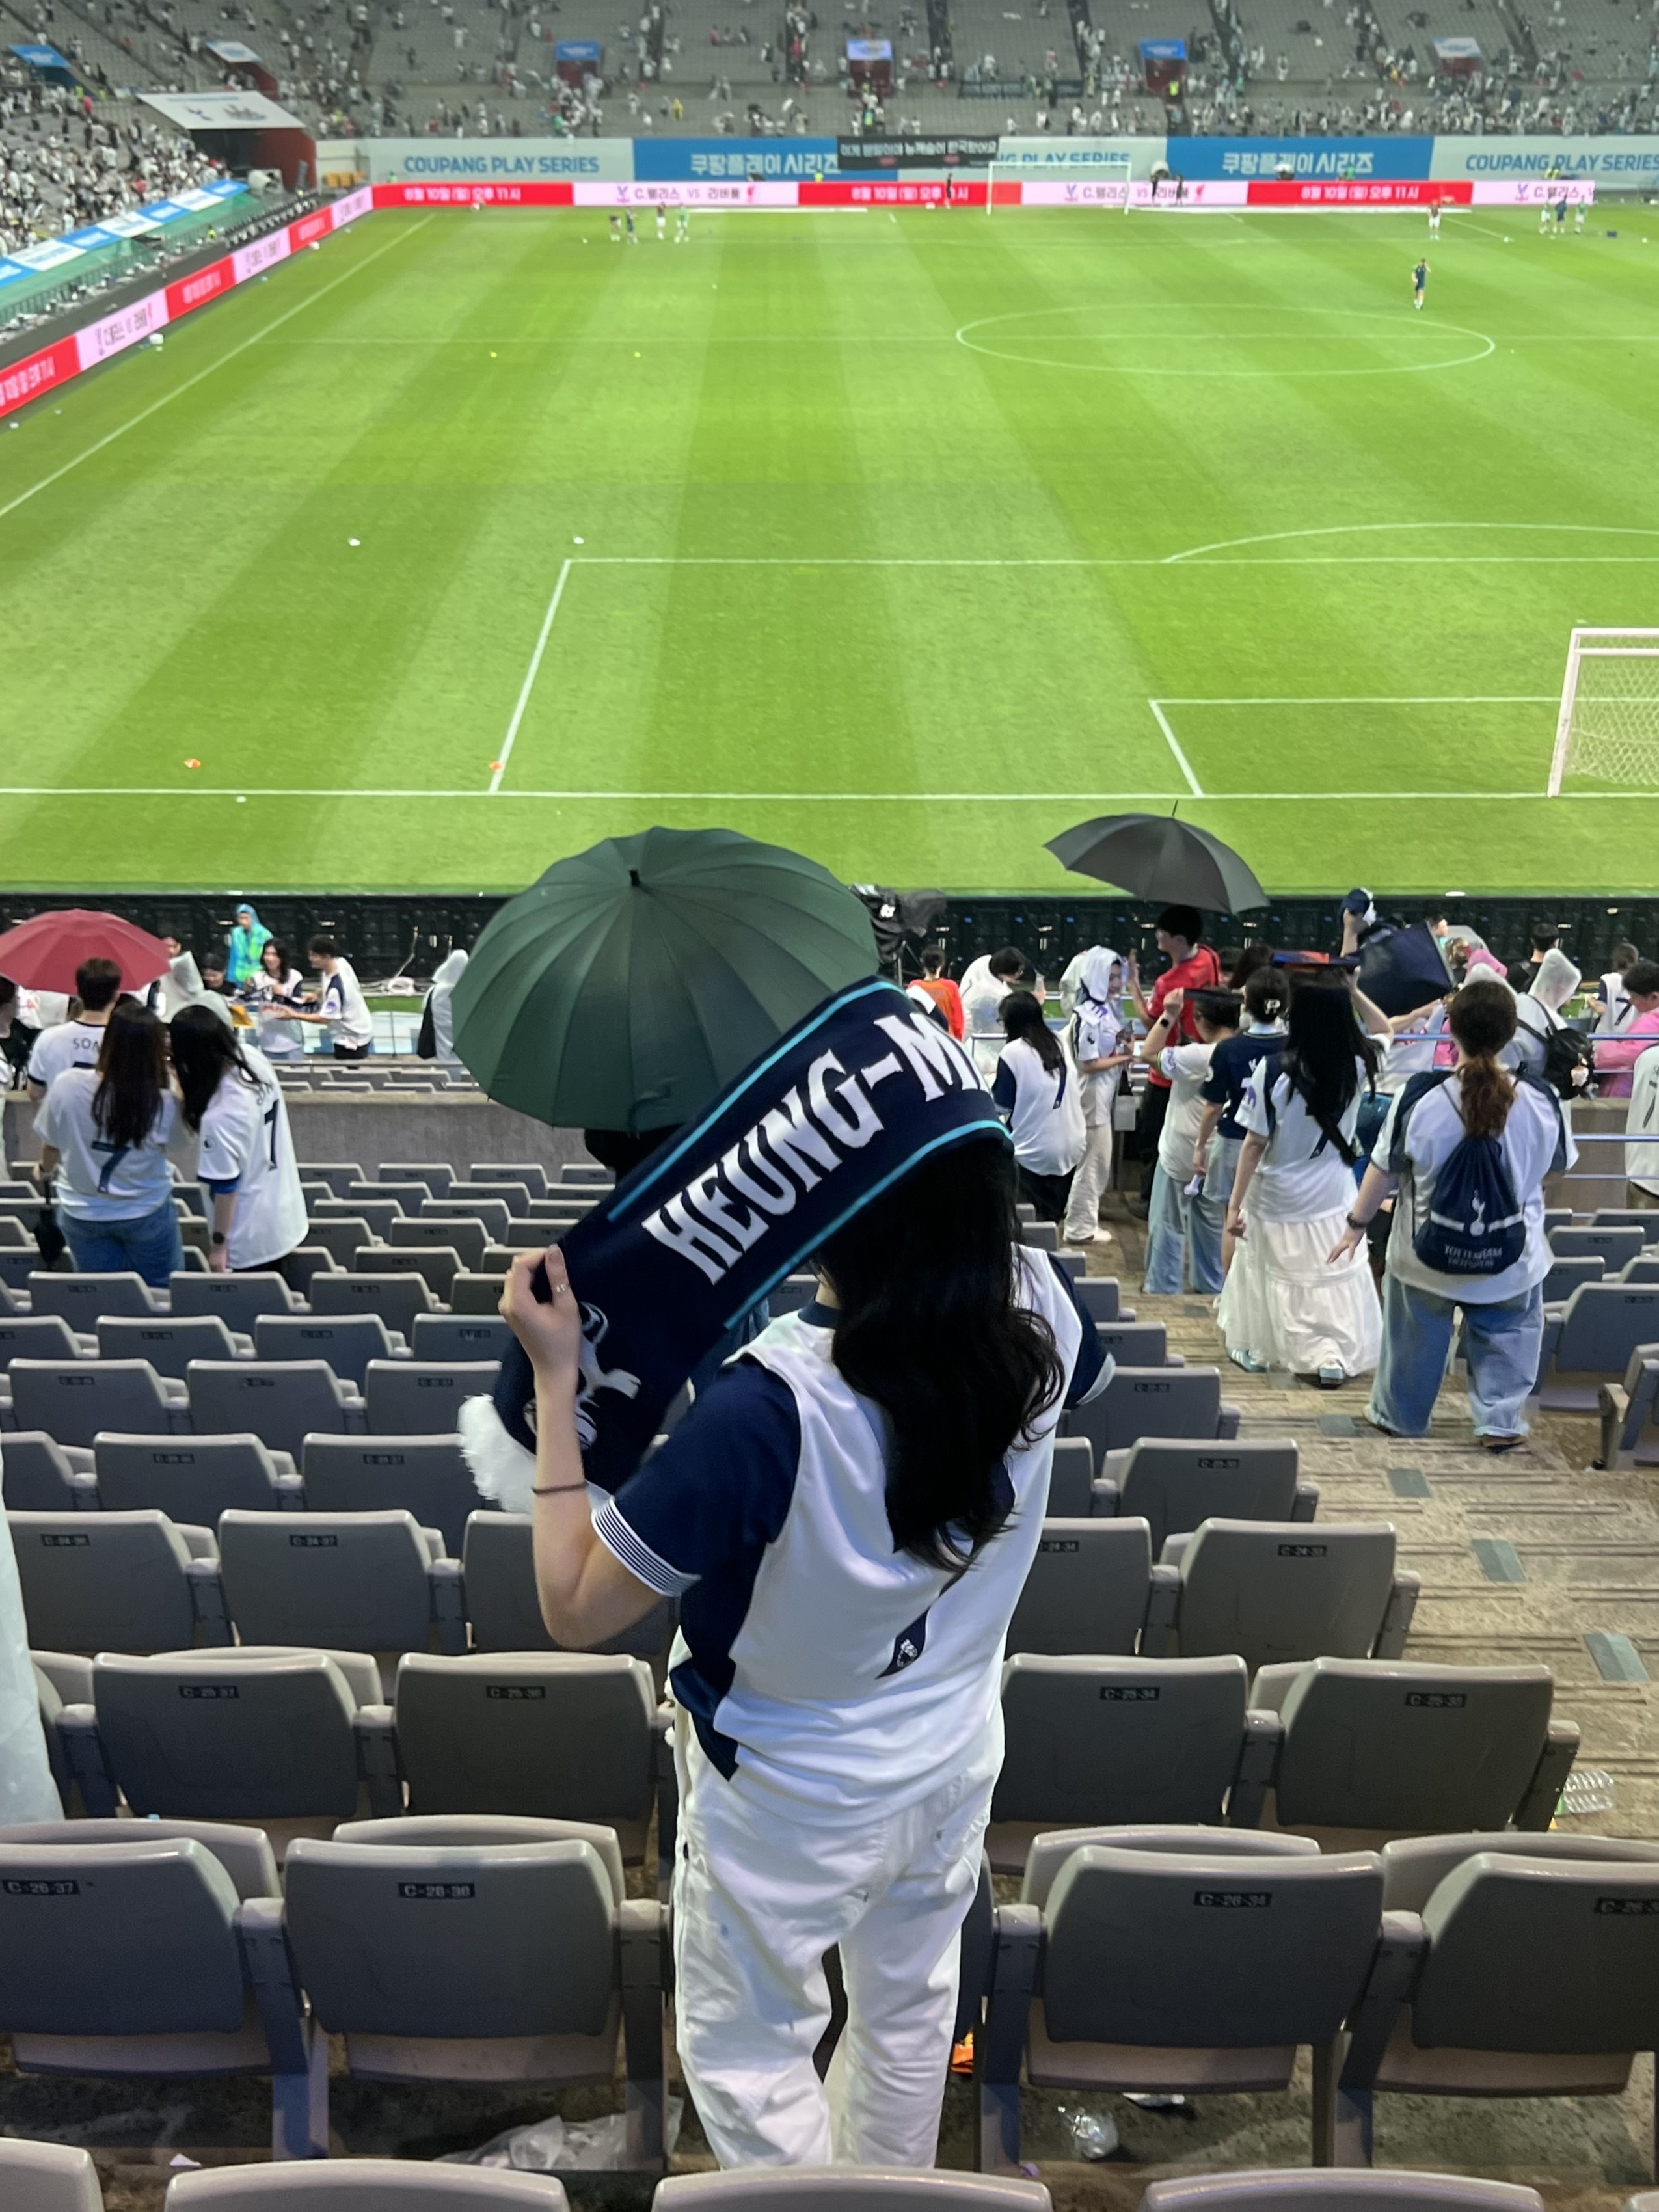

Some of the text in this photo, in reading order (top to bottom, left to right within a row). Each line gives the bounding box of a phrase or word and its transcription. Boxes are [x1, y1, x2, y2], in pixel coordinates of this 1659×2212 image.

[405, 156, 600, 174] COUPANG PLAY SERIES
[1465, 154, 1550, 172] COUPANG
[1554, 154, 1600, 172] PLAY
[92, 1140, 131, 1193] 7
